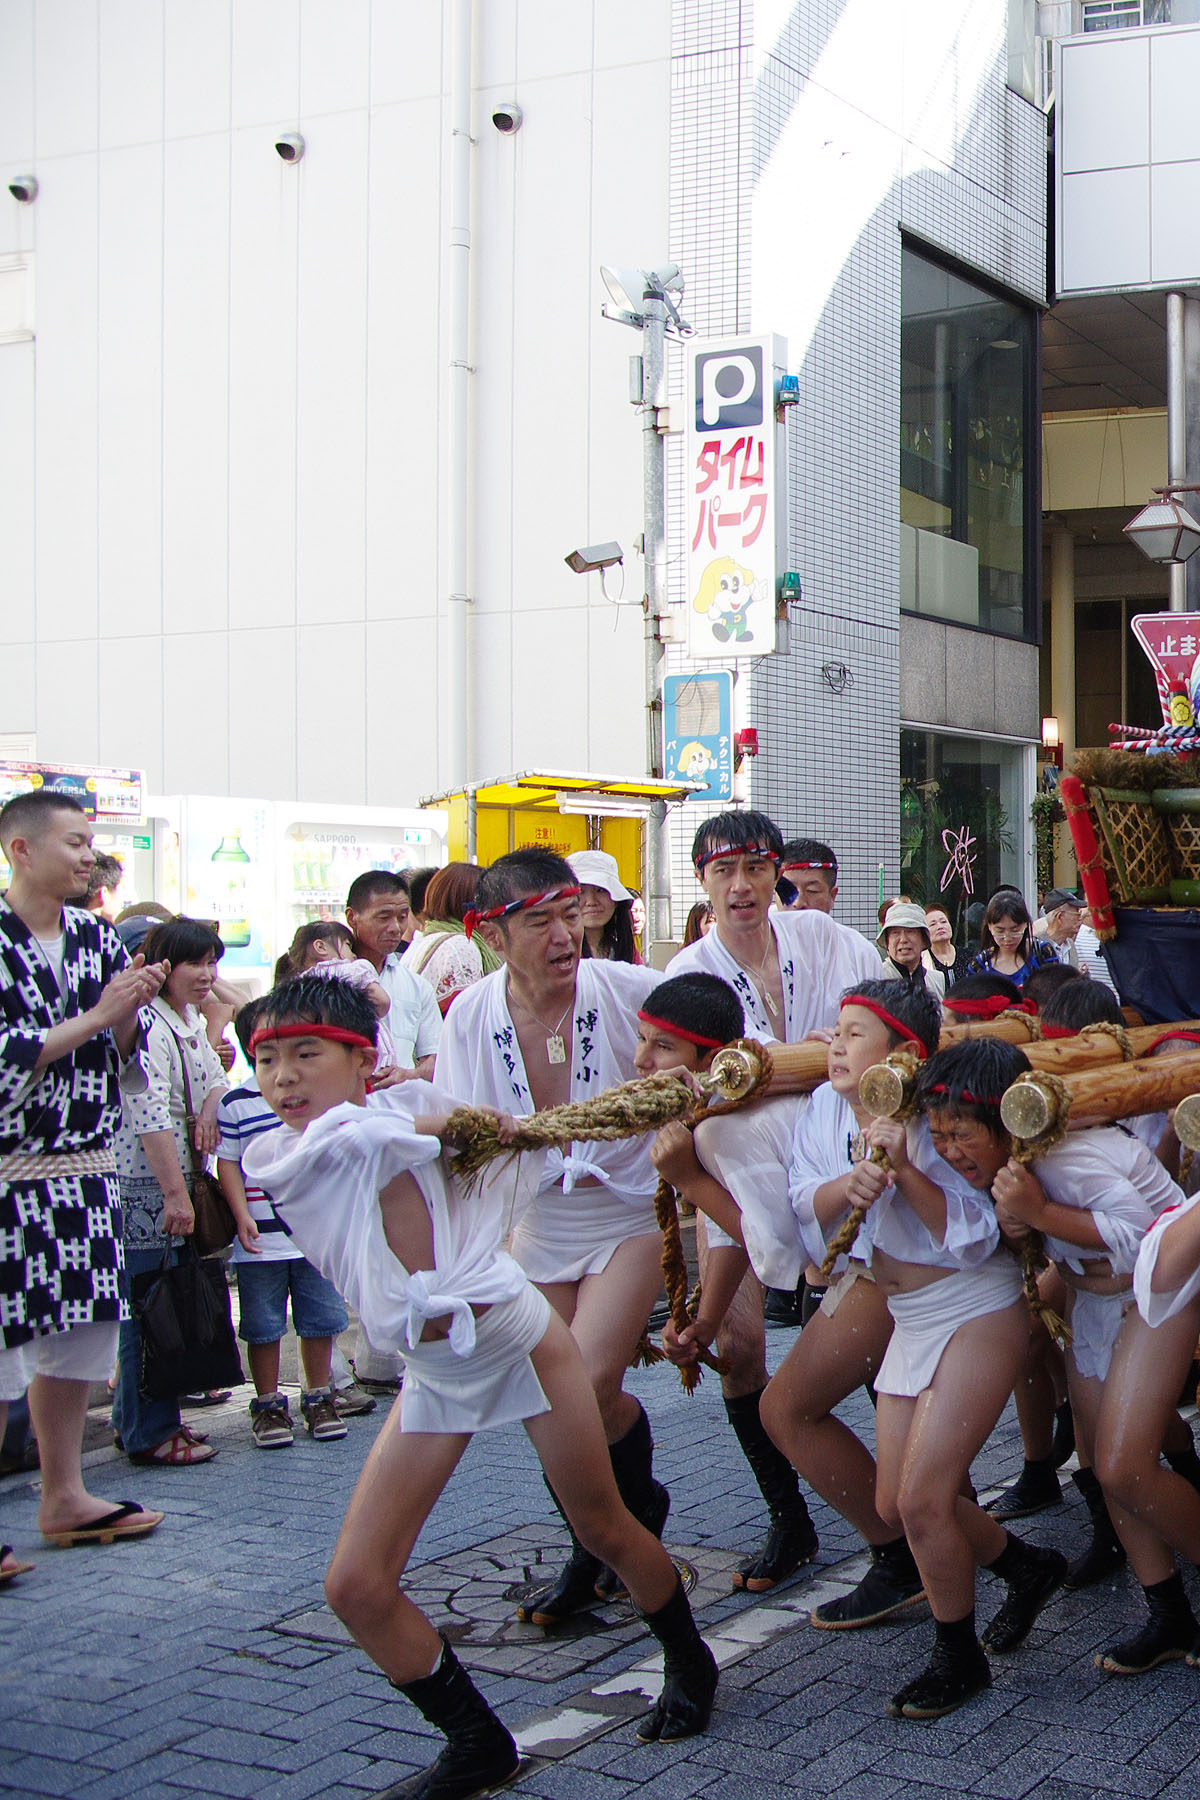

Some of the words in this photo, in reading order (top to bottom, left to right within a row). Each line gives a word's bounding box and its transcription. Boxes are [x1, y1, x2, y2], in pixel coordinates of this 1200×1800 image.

[702, 354, 757, 427] P
[695, 435, 764, 495] タイム
[692, 493, 769, 553] パーク
[666, 739, 677, 781] パーク
[718, 736, 730, 794] テクニカル
[313, 833, 357, 846] SAPPORO
[493, 1026, 528, 1099] 博多小
[575, 1008, 599, 1083] 博多小
